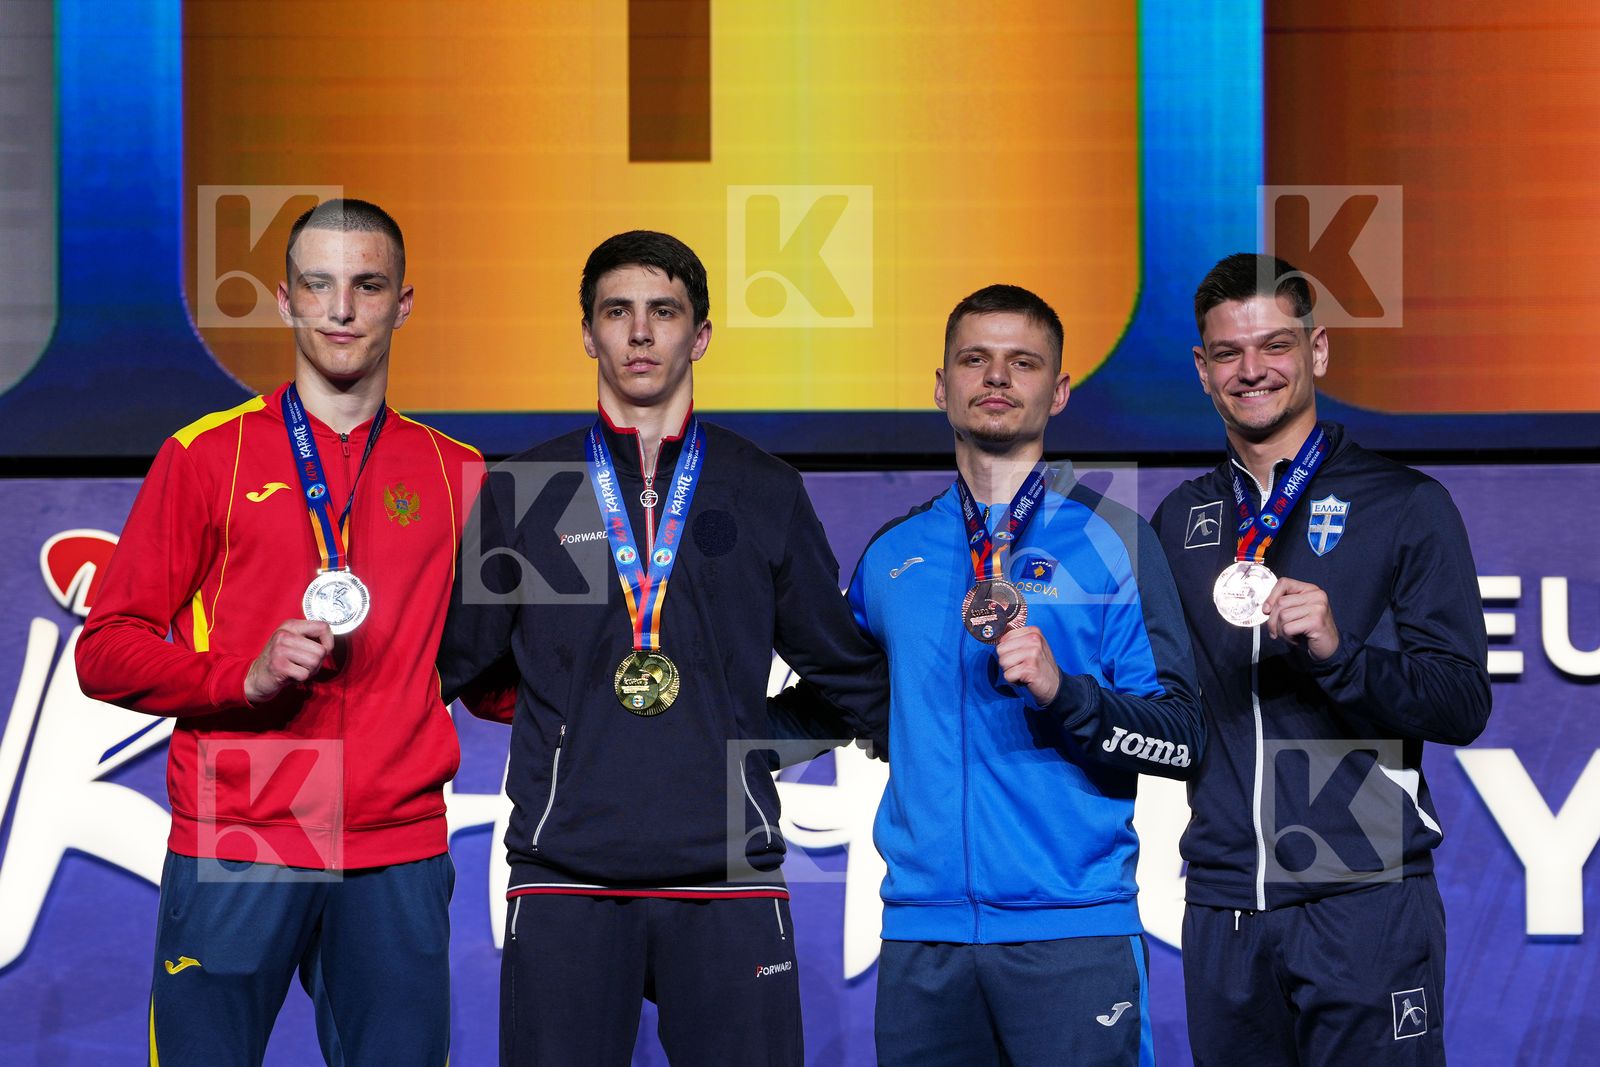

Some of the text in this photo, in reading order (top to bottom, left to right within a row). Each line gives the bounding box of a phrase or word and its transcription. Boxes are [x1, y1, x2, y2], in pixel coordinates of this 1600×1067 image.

[293, 424, 313, 459] KARATE
[596, 470, 621, 513] KARATE
[670, 473, 693, 516] KARATE
[1283, 465, 1308, 500] KARATE
[1013, 495, 1034, 521] KARATE
[560, 530, 608, 546] FORWARD
[1013, 581, 1058, 598] OSOVA
[756, 960, 792, 978] FORWARD
